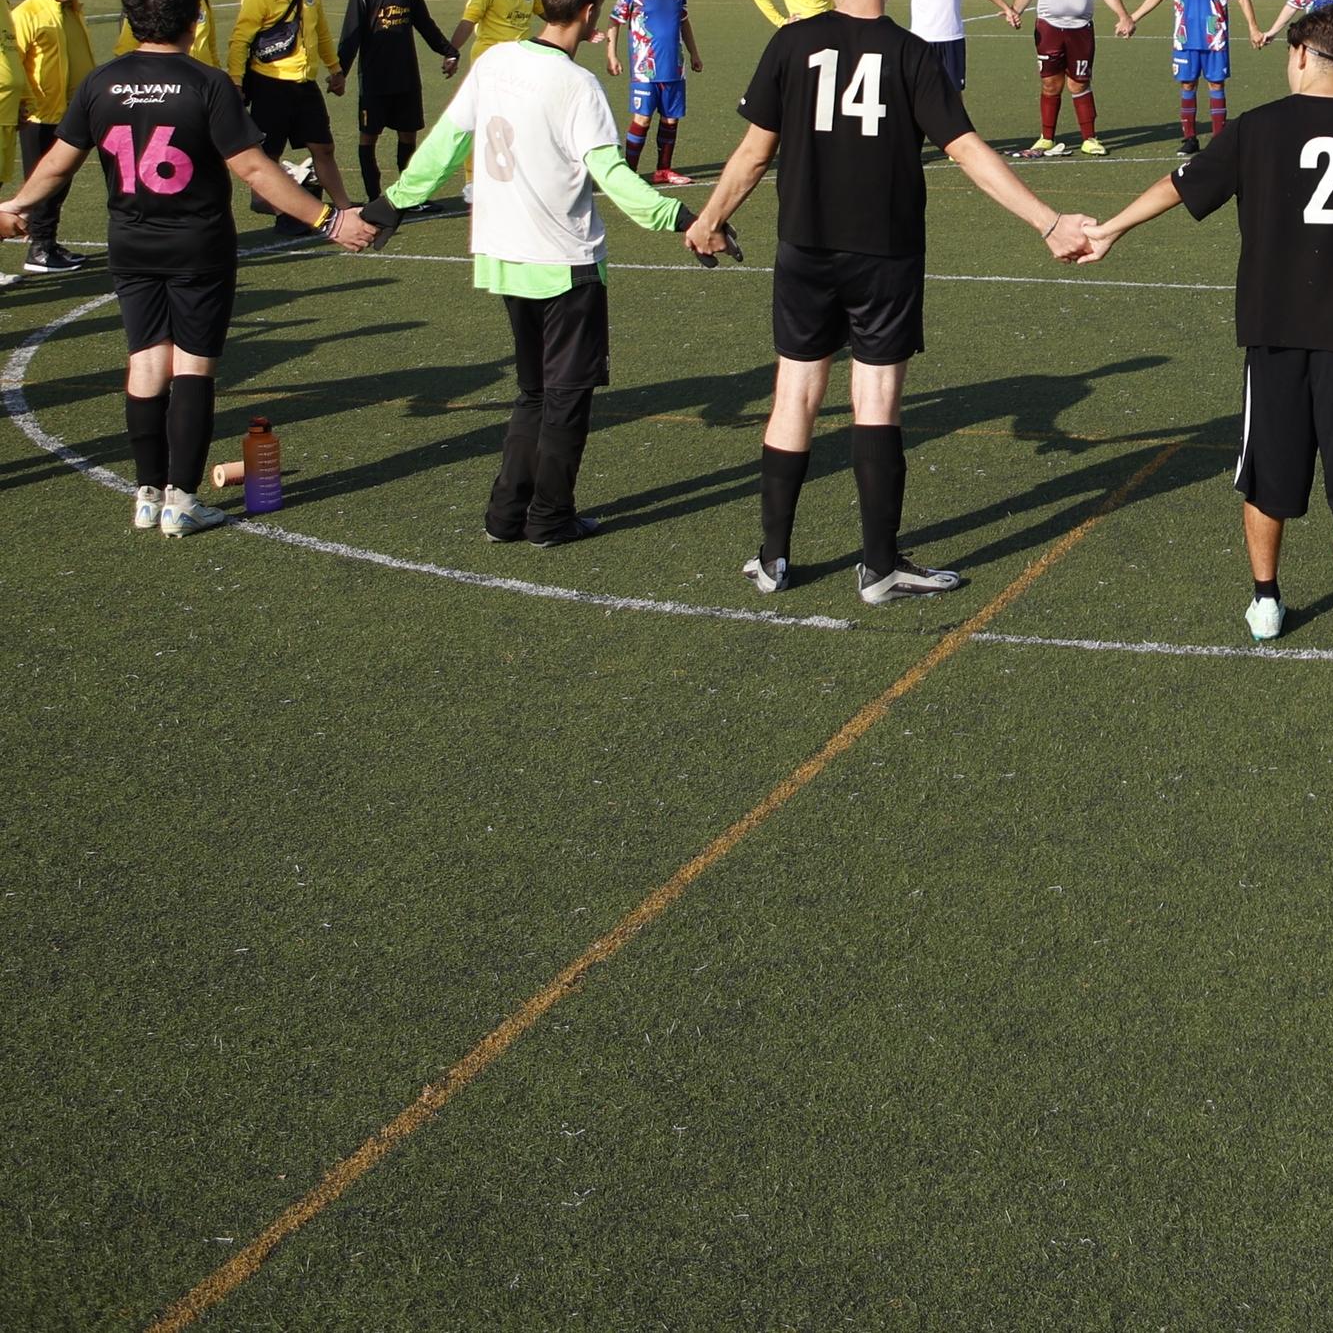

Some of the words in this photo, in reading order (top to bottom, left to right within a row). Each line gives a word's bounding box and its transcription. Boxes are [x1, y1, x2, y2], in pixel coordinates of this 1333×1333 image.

[1076, 60, 1088, 76] 12
[110, 84, 182, 95] GALVANI
[122, 92, 166, 109] Special
[808, 48, 887, 136] 14
[102, 125, 194, 195] 16
[485, 115, 516, 183] 8
